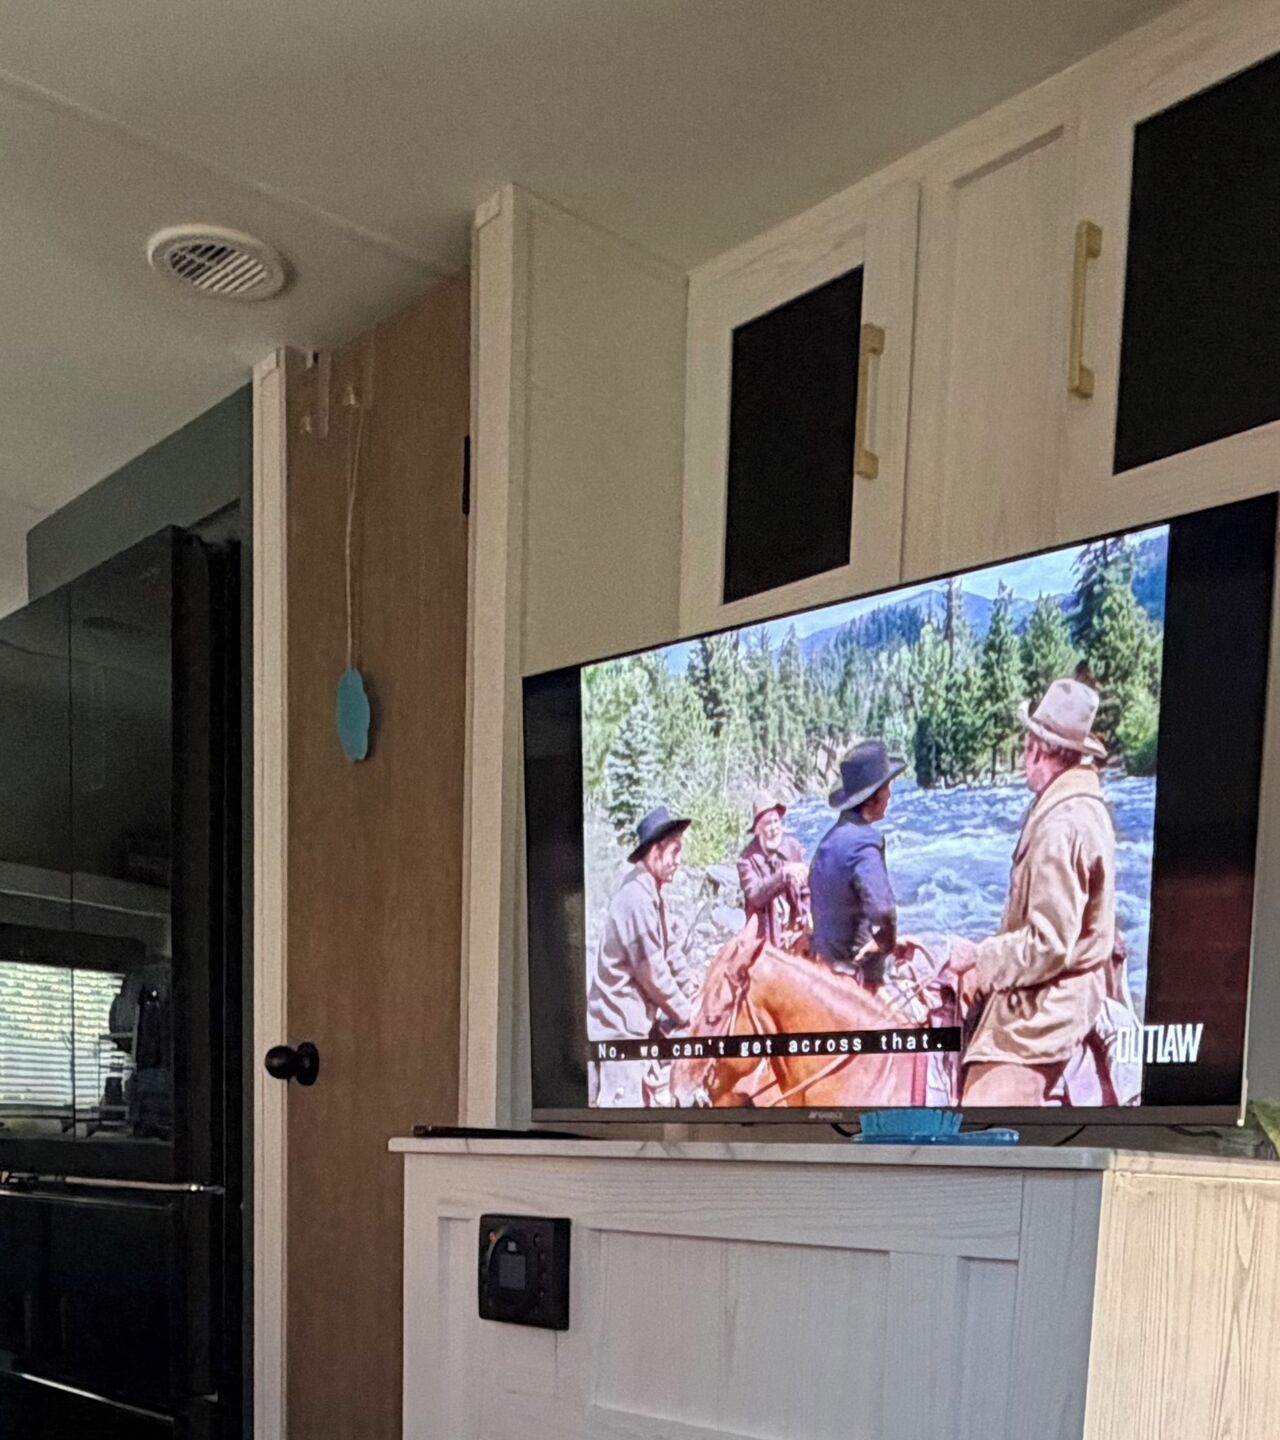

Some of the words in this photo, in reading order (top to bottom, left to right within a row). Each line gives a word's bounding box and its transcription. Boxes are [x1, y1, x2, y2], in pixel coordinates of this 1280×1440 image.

[598, 1043, 625, 1059] No,
[640, 1045, 659, 1057] we
[673, 1039, 724, 1056] can't
[740, 1039, 772, 1057] get
[788, 1037, 862, 1053] across
[881, 1032, 942, 1050] that.
[1117, 1023, 1204, 1063] OUTLAW
